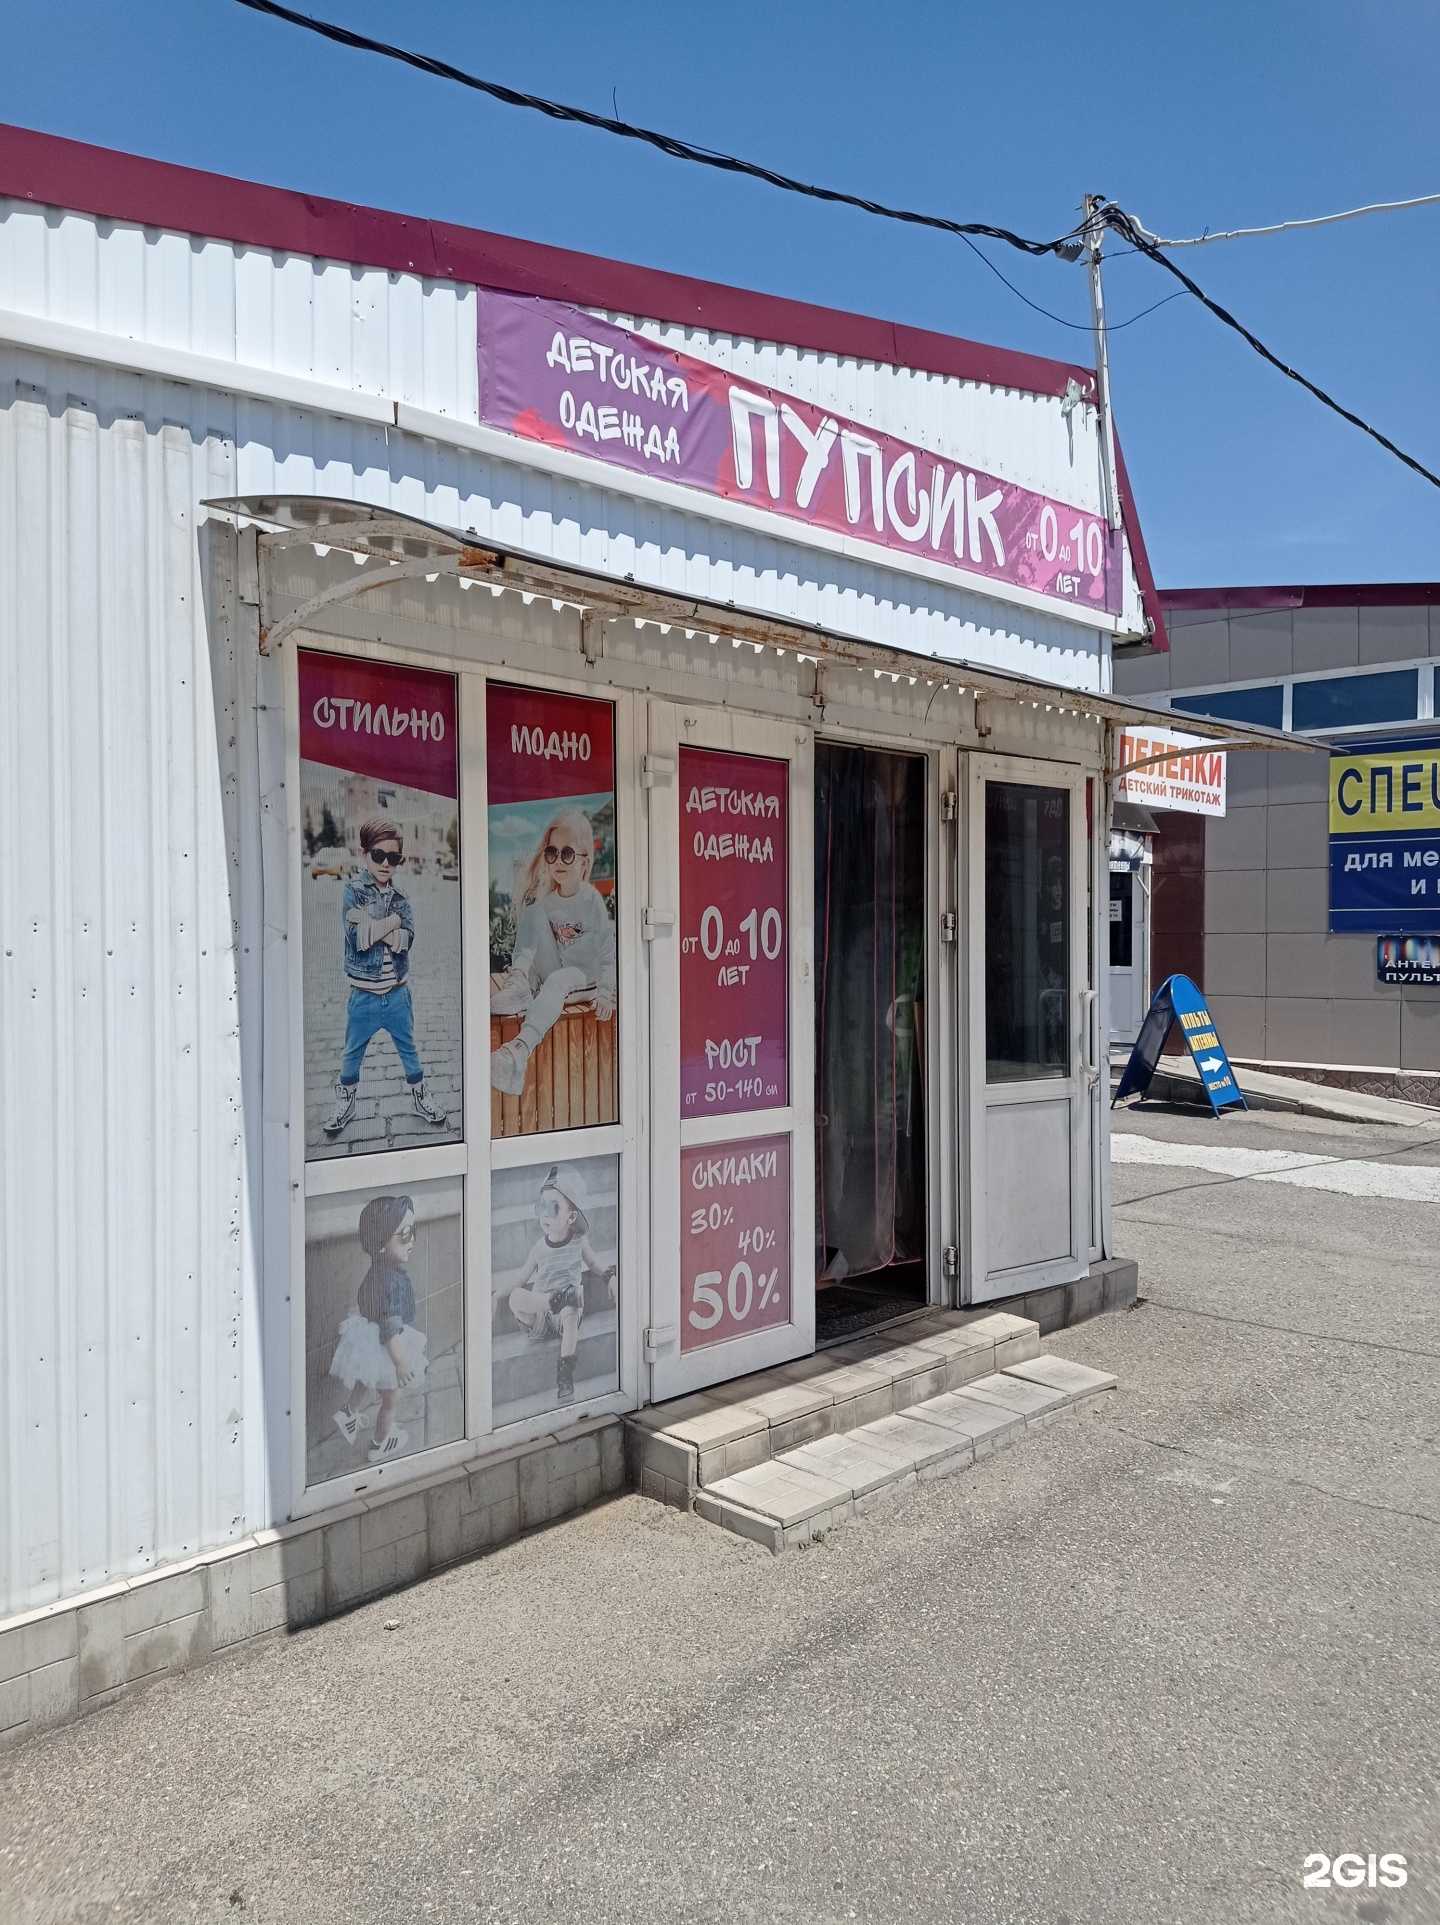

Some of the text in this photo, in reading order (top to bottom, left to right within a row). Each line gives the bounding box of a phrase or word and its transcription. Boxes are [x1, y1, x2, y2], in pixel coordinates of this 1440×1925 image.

[546, 331, 689, 413] ДЕТСКАЯ
[560, 390, 681, 465] ОДЕЖДА
[728, 385, 1006, 567] ПУПСИК
[1025, 505, 1103, 577] ОТ 0 ДО 10
[1056, 571, 1081, 598] ЛЕТ
[312, 696, 446, 742] СТИЛЬНО
[510, 724, 592, 761] МОДНО
[1119, 734, 1222, 788] ПЕЛЕНКИ
[685, 786, 780, 819] ДЕТСКАЯ
[1118, 776, 1222, 806] ДЕТСКИЙ ТРИКОТАЖ
[693, 831, 775, 864] ОДЕЖДА
[1344, 852, 1394, 872] для
[1411, 878, 1427, 895] и
[682, 905, 783, 961] ОТ 0 ДО 10
[717, 965, 750, 987] ЛЕТ
[705, 1035, 763, 1070] РОСТ
[685, 1092, 698, 1105] ОТ
[704, 1077, 764, 1102] 50-140
[691, 1150, 778, 1190] СКИДКИ
[690, 1202, 735, 1235] 30%
[737, 1225, 776, 1256] 40%
[688, 1260, 781, 1330] 50%
